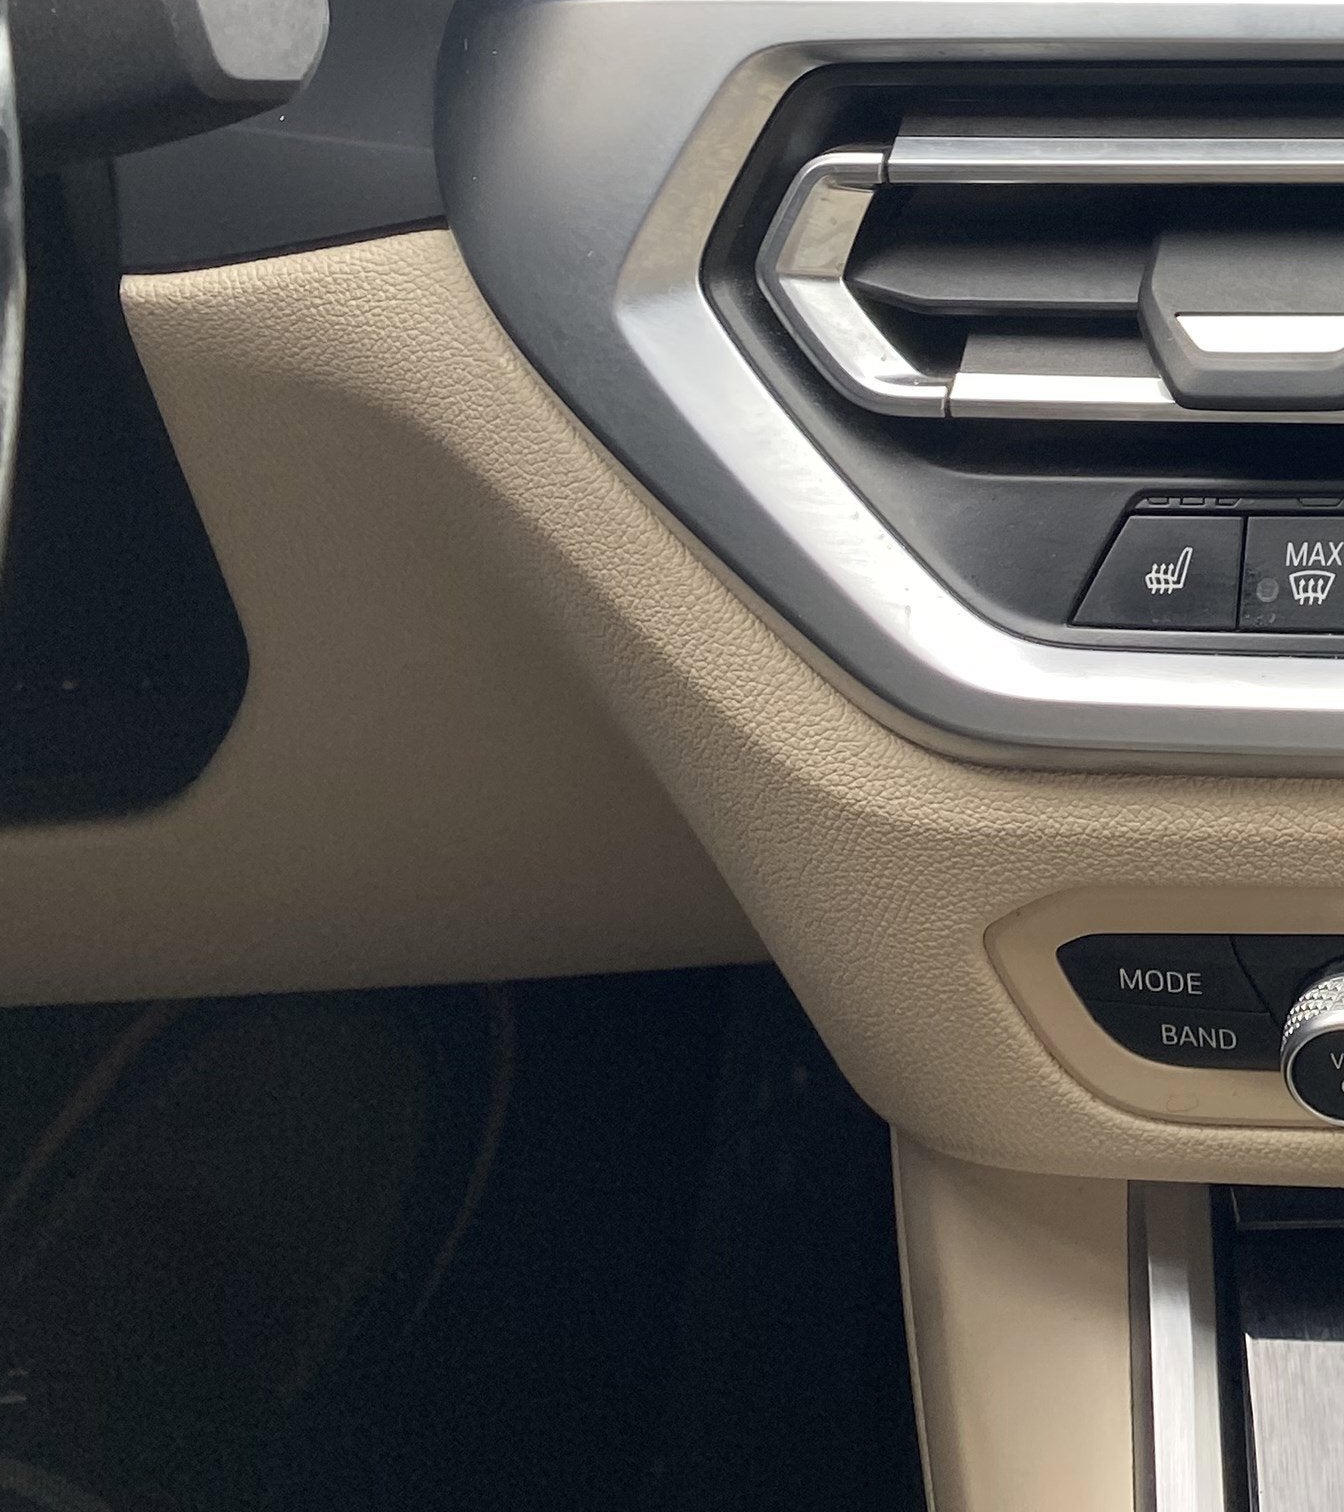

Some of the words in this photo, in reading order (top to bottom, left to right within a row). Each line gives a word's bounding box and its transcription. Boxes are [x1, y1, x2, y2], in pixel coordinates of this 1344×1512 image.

[1286, 542, 1343, 566] MAX
[1120, 968, 1202, 994] MODE
[1162, 1024, 1236, 1049] BAND
